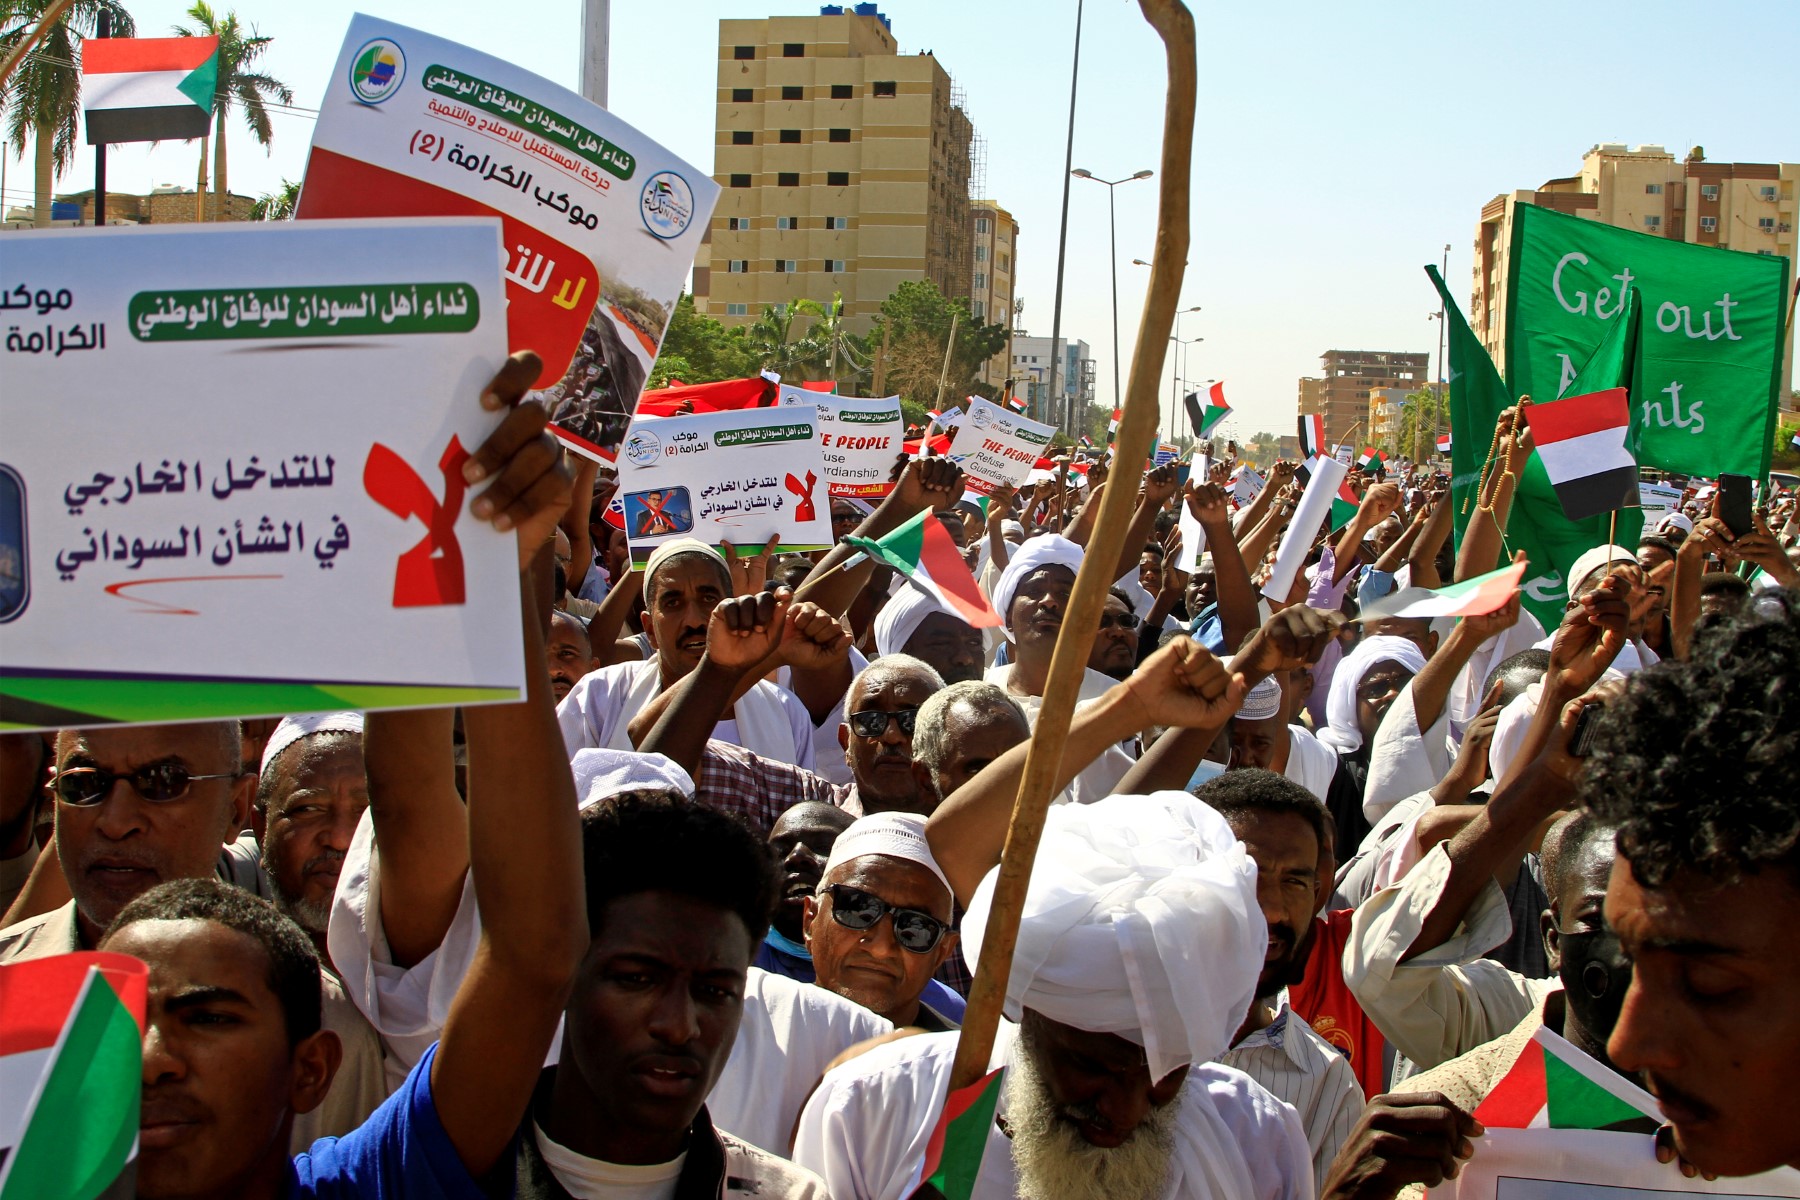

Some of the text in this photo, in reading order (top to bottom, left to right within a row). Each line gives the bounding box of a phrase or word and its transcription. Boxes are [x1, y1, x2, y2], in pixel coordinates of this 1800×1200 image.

[427, 71, 631, 171] نداء أهل السودان للوفاق الوطني
[427, 98, 611, 191] حركة المستقبل للإصلاح والتنمية
[409, 129, 600, 231] موكب الكرامة (2)
[552, 276, 587, 310] لا
[1552, 251, 1743, 342] Get out
[135, 285, 468, 338] نداء أهل السودان للوفاق الوطني
[6, 322, 106, 357] الكرامة
[672, 431, 699, 443] موكب
[716, 431, 740, 446] الوطني
[740, 429, 761, 441] للوفاق
[761, 428, 785, 439] السودان
[786, 426, 797, 438] أهل
[836, 435, 890, 450] PEOPLE
[664, 445, 679, 457] (2)
[679, 441, 709, 454] الكرامة
[975, 451, 1005, 469] Refuse
[981, 438, 1036, 465] THE PEOPLE
[63, 453, 336, 516] للتدخل الخارجي
[700, 477, 778, 500] للتدخل الخارجي
[784, 469, 818, 522] لا
[831, 484, 857, 496] يرفض
[857, 484, 884, 495] الشعب
[362, 432, 472, 608] لا
[699, 494, 784, 520] في الشأن السوداني
[55, 514, 351, 582] في الشأن السوداني
